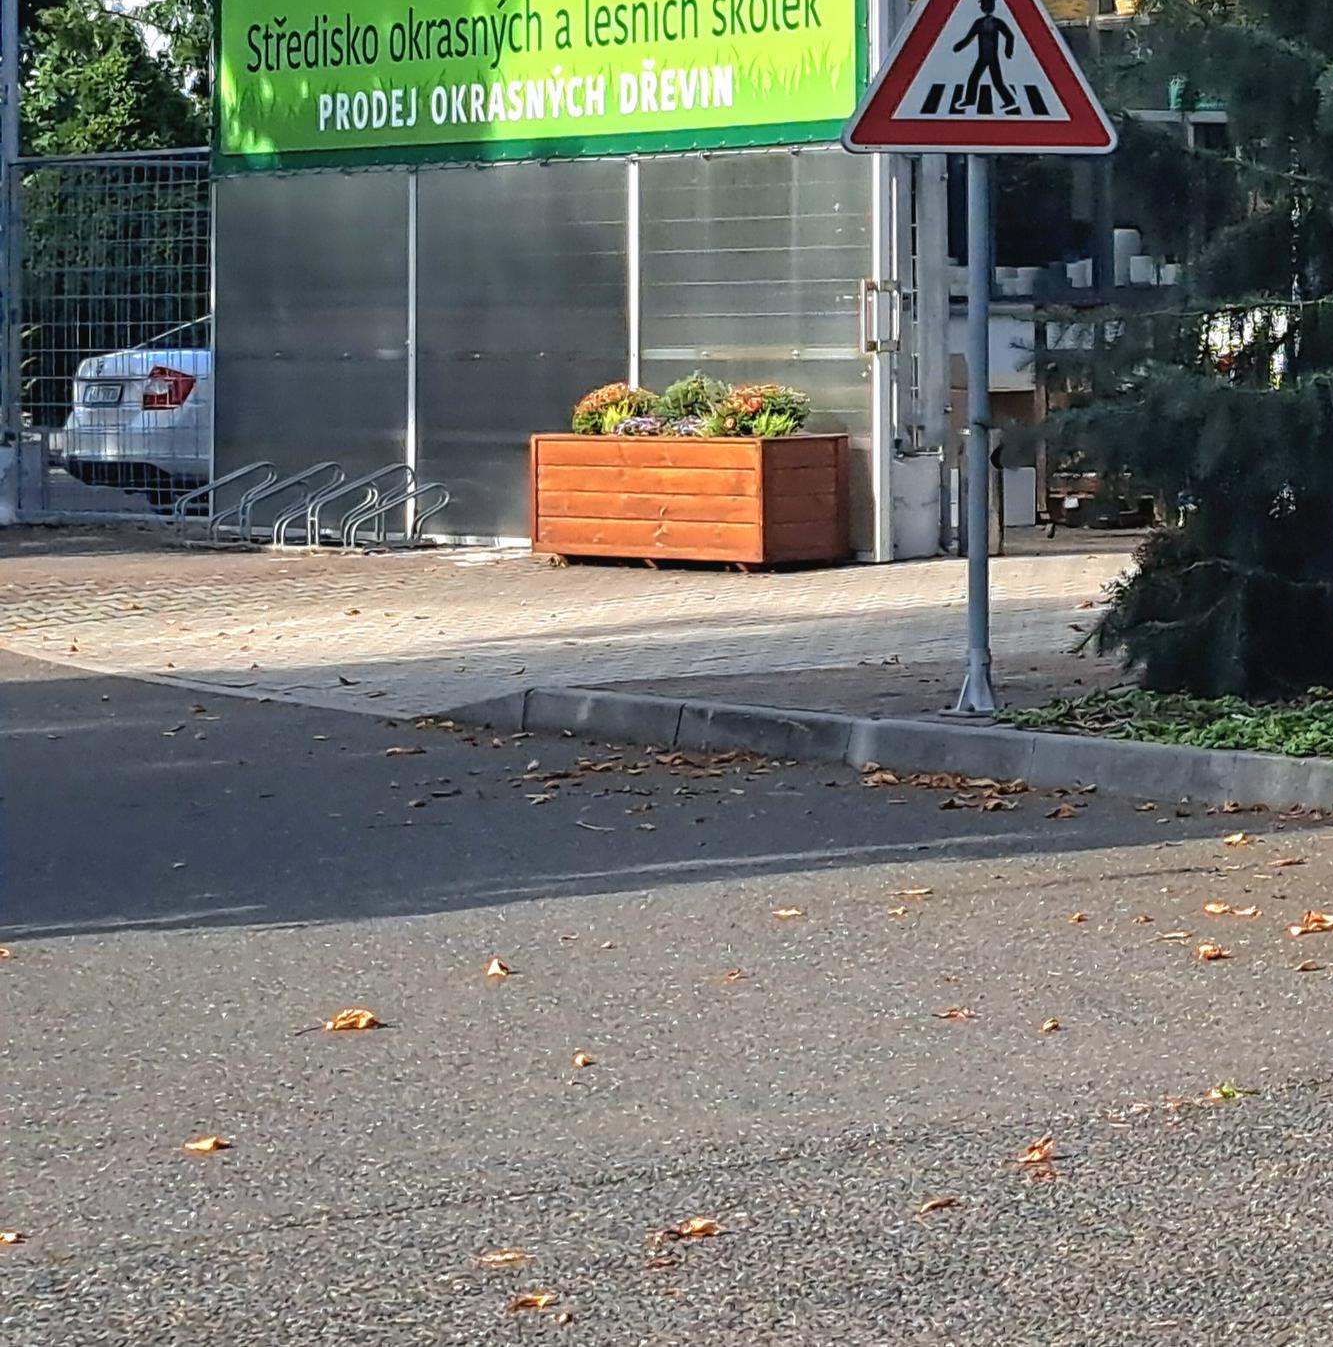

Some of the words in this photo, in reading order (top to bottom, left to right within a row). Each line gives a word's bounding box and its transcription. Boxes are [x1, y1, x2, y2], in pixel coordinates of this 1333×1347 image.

[246, 14, 379, 74] Středisko
[555, 8, 573, 50] a
[318, 85, 419, 132] PRODEJ
[431, 63, 606, 126] OKRASNÝCH
[618, 57, 734, 116] DŘEVIN
